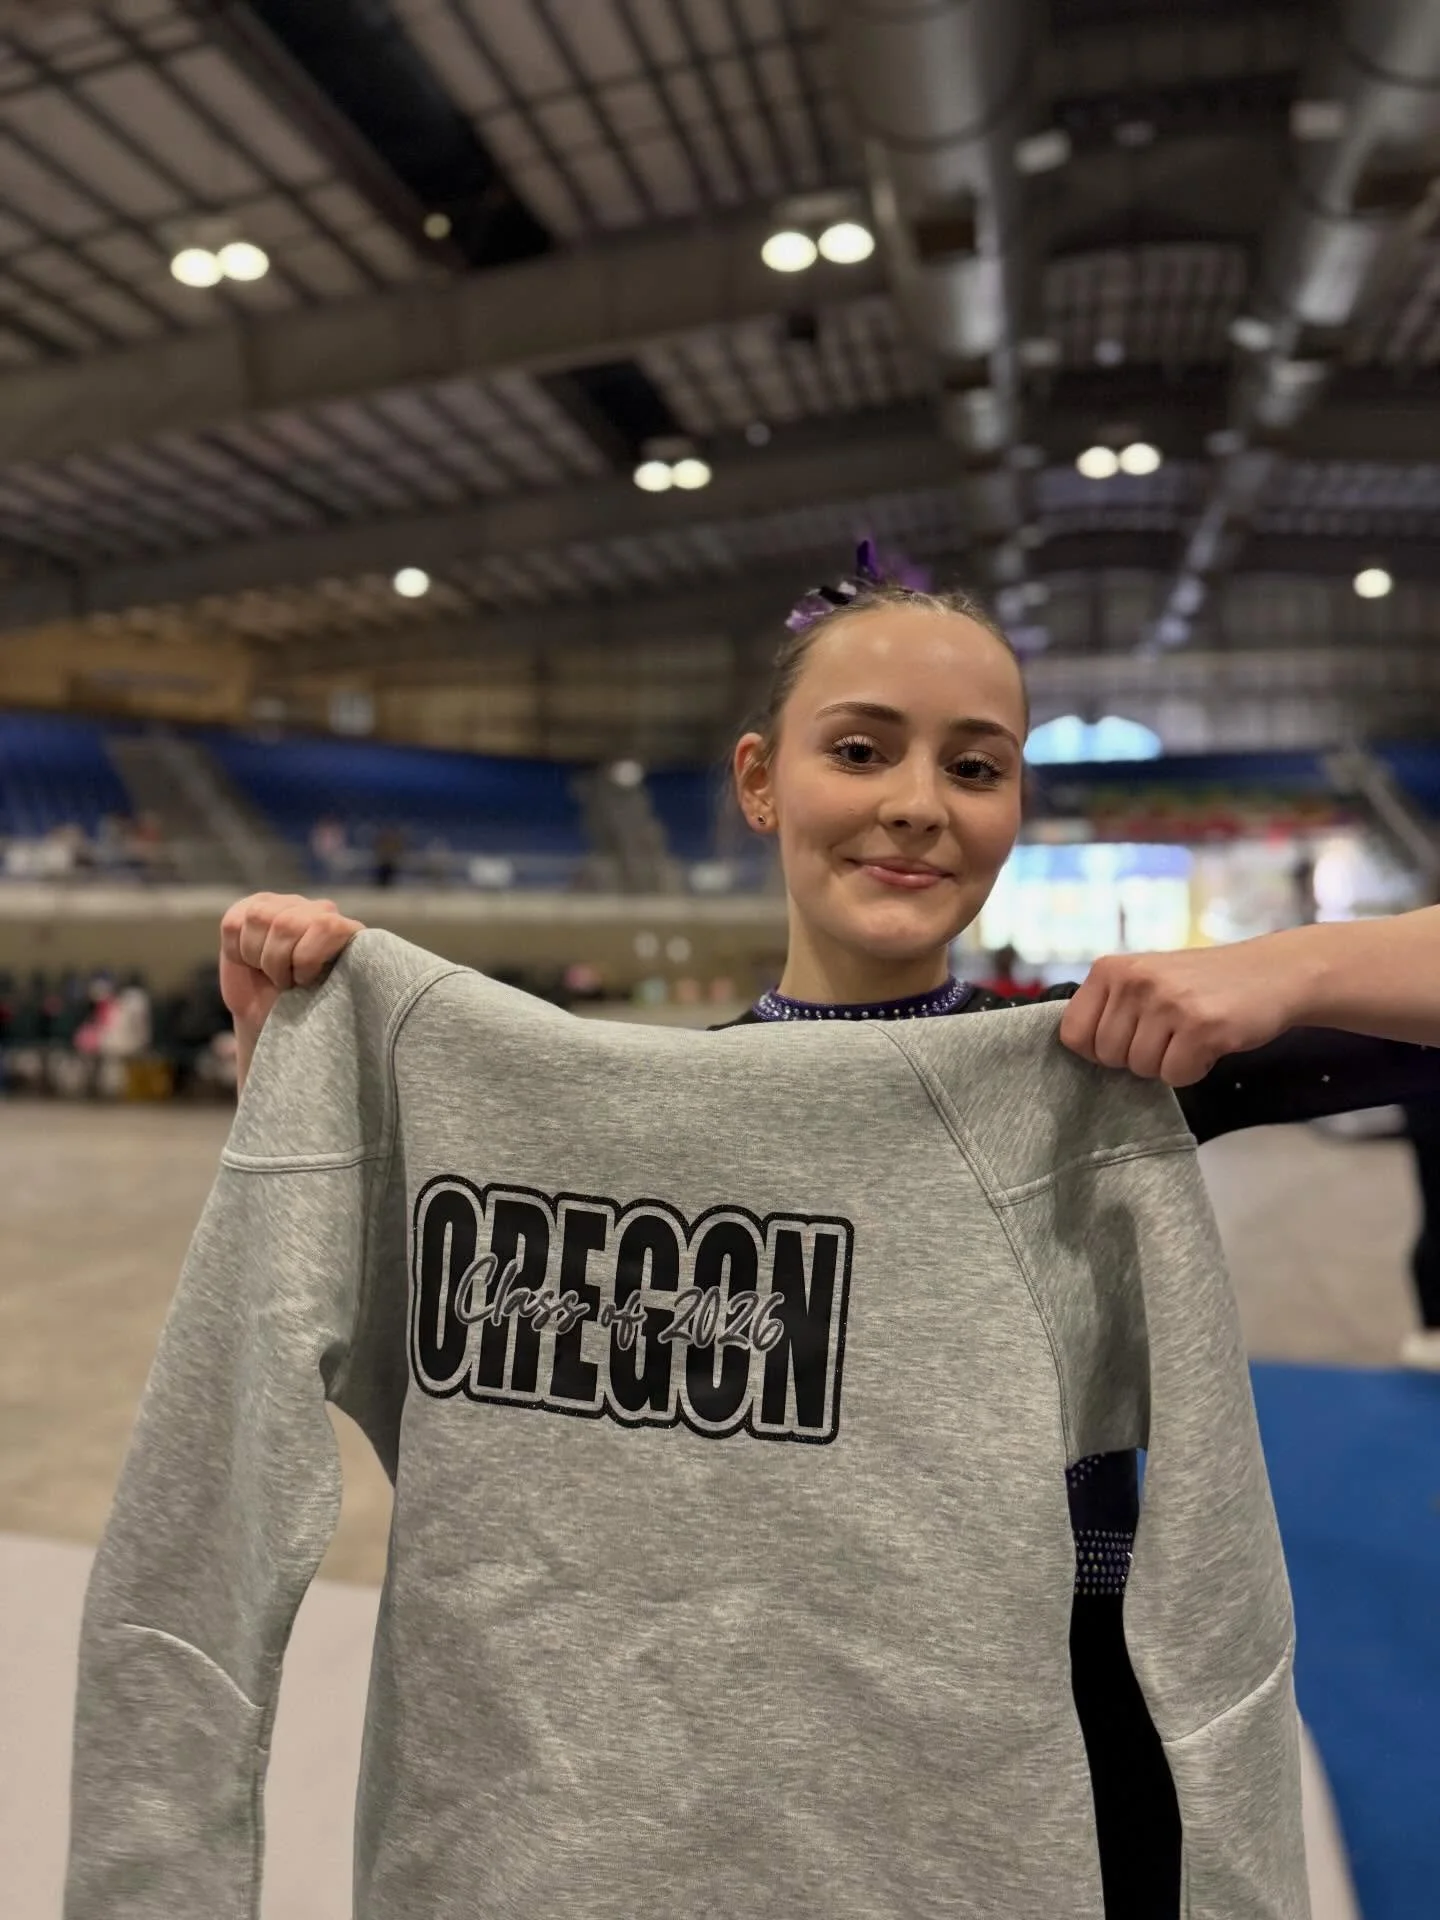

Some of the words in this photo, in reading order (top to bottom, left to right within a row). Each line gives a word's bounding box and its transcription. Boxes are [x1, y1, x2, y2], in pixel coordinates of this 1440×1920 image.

[417, 1188, 840, 1429] OREGON
[455, 1252, 589, 1333] Class
[600, 1289, 647, 1351] of
[658, 1286, 785, 1351] 2026
